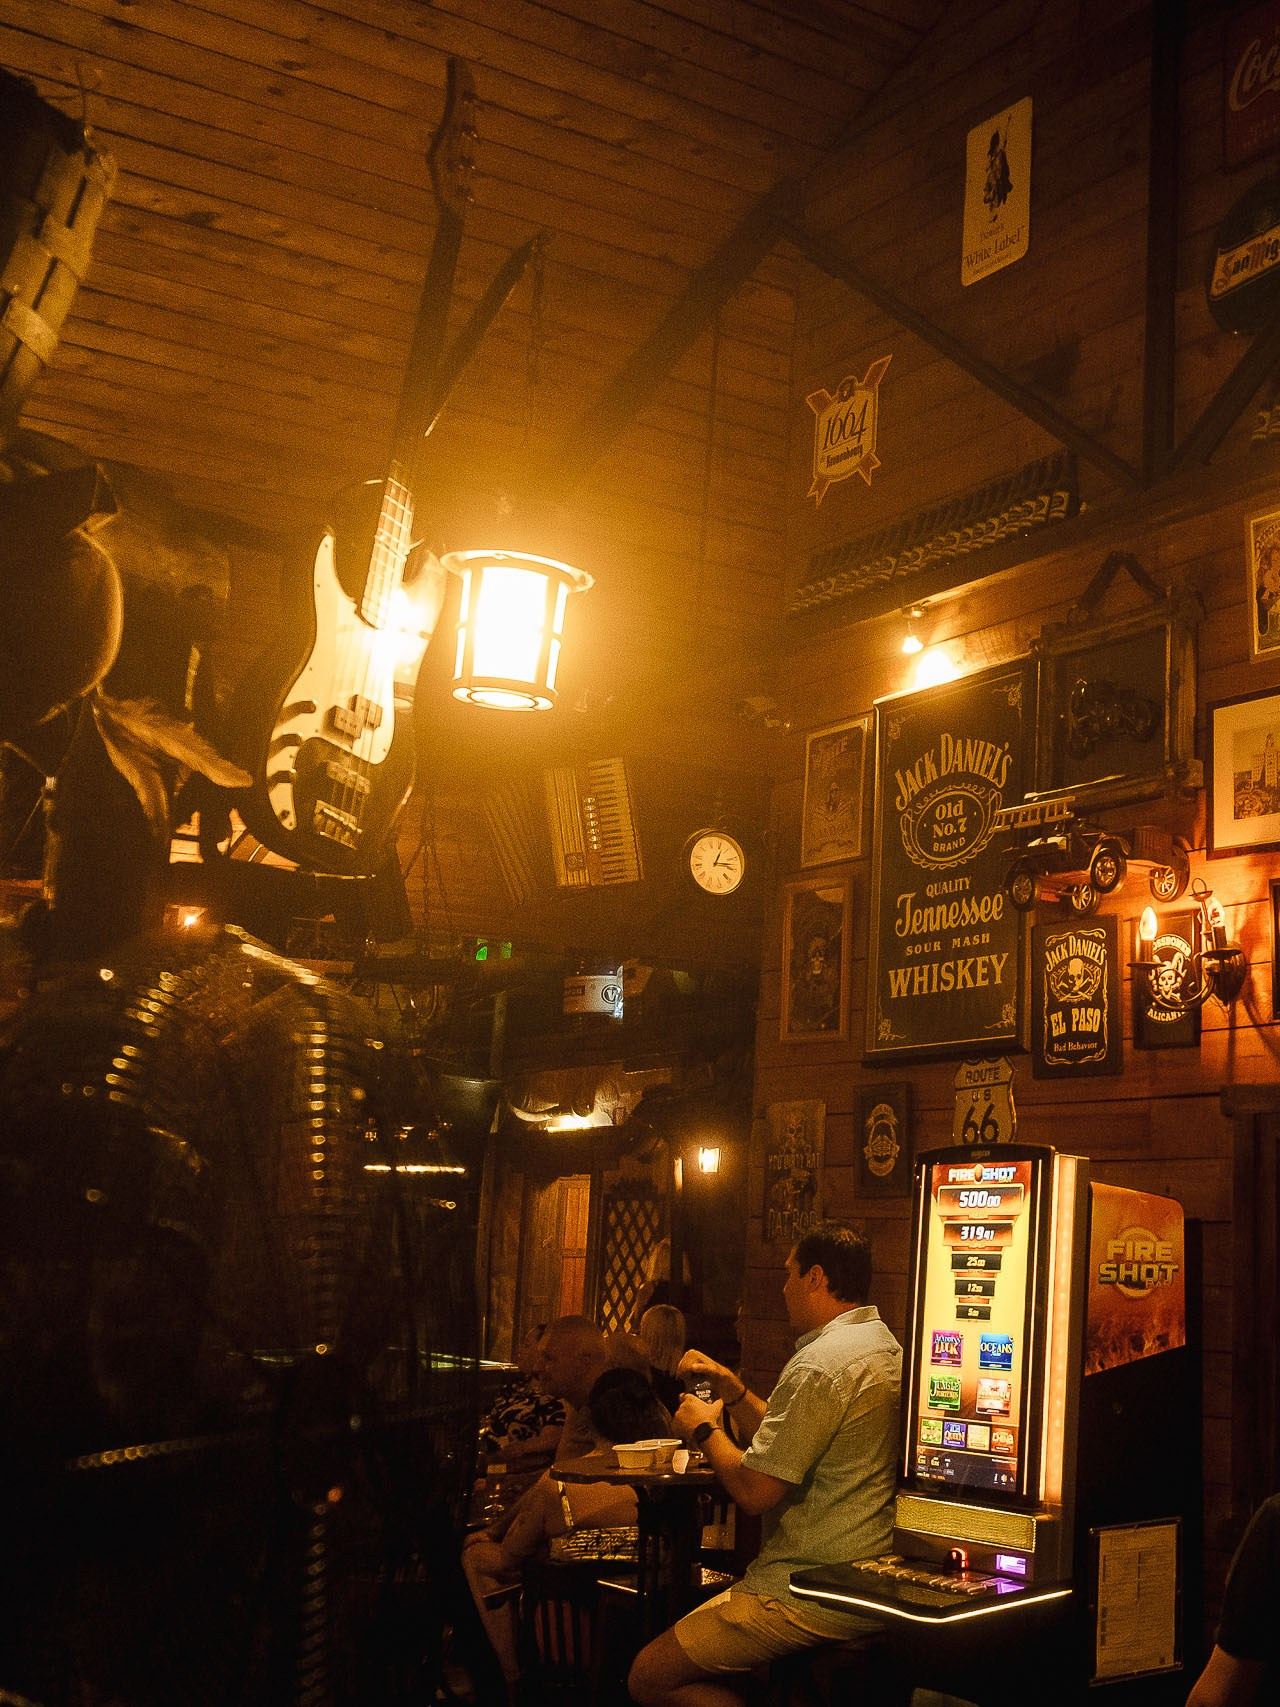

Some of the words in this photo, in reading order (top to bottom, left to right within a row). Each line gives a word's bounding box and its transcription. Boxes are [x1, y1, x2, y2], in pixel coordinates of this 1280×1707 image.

[823, 400, 868, 451] 1664
[895, 749, 939, 811] JACK
[940, 733, 1013, 789] DANIEL'S
[935, 799, 964, 821] Old
[933, 836, 966, 852] BRAND
[926, 876, 972, 898] QUALITY
[895, 892, 1004, 938] Tennessee
[906, 941, 942, 956] SOUR
[952, 933, 990, 949] MASH
[1045, 939, 1069, 972] JACK
[1068, 935, 1107, 966] DANIEL'S
[888, 952, 1009, 999] WHISKEY
[1050, 1011, 1066, 1037] EL
[1072, 1007, 1101, 1034] PASO
[1068, 1040, 1098, 1051] Behavior
[965, 1065, 1001, 1083] ROUTE
[962, 1103, 999, 1144] 66
[948, 1168, 974, 1182] FIRE
[982, 1166, 1017, 1181] SHOT
[1107, 1240, 1174, 1262] FIRE
[1098, 1263, 1179, 1285] SHOT
[935, 1342, 959, 1355] LUCK
[980, 1342, 1013, 1354] OCEANS
[931, 1380, 959, 1396] JUNGLE
[944, 1431, 965, 1442] QUEEN
